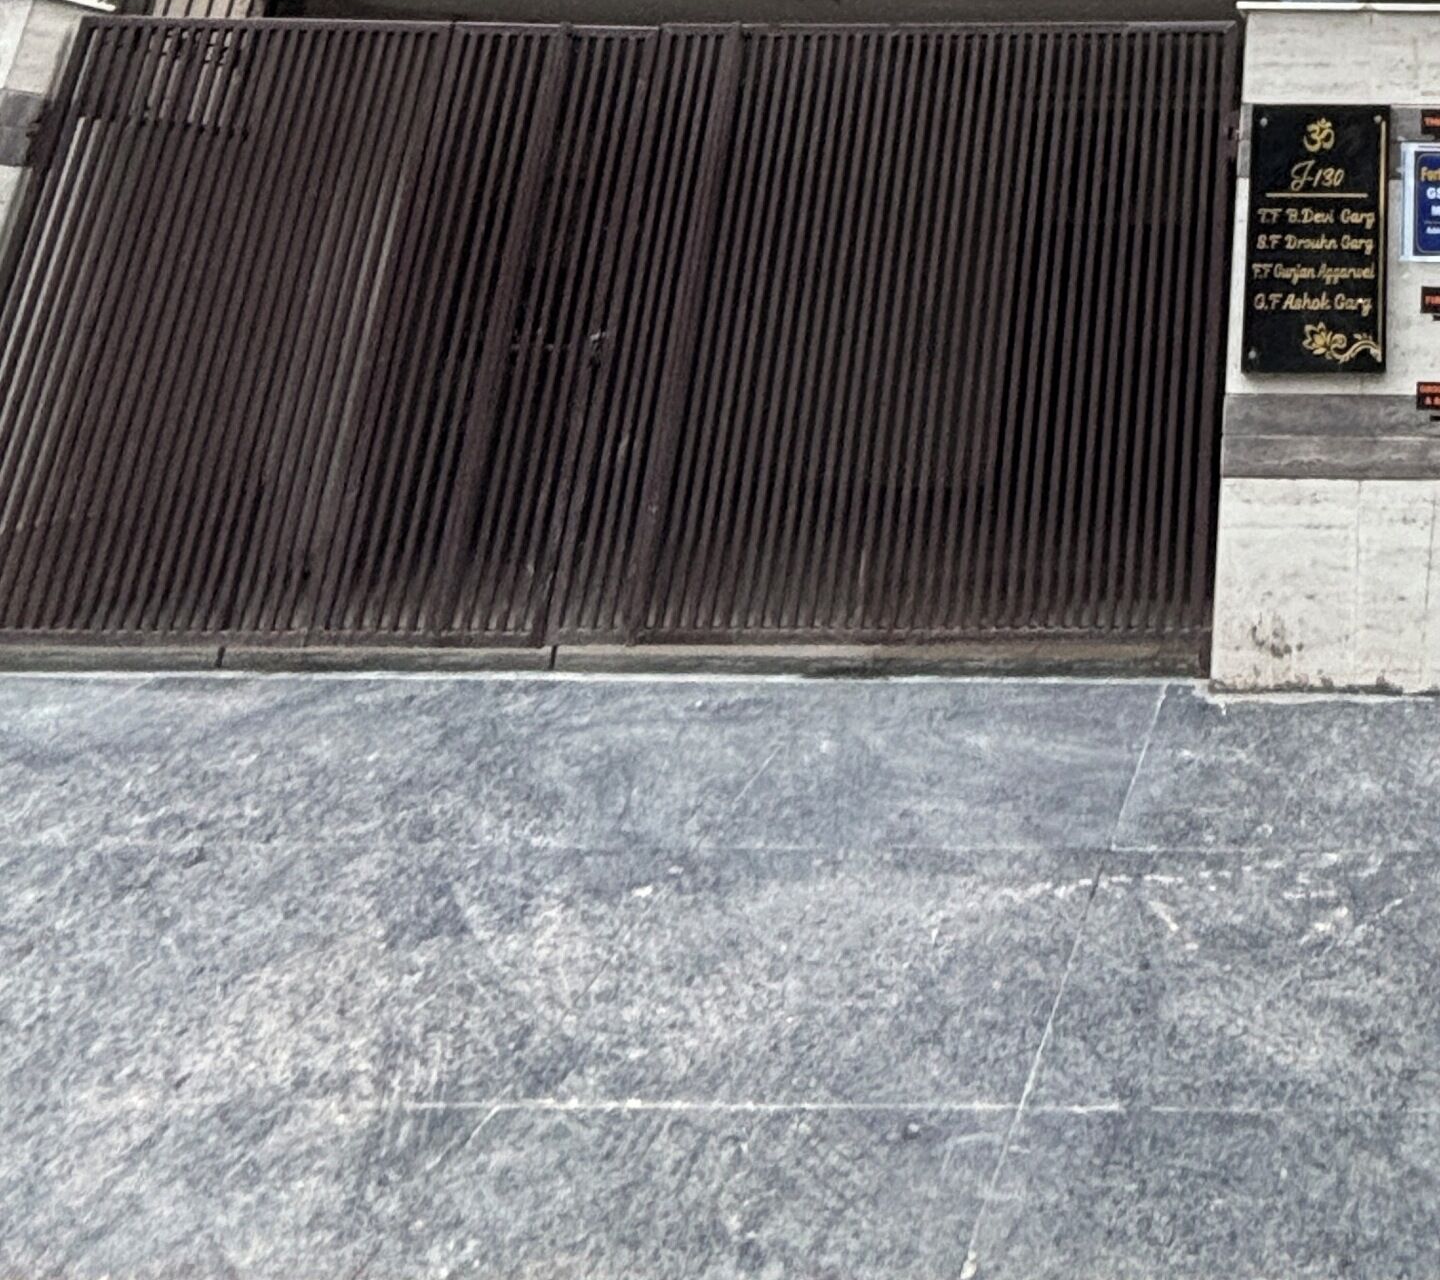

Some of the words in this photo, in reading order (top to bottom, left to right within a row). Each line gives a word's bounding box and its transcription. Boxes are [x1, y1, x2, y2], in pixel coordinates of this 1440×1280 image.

[1340, 208, 1376, 229] Garg
[1340, 234, 1374, 255] Garg
[1282, 291, 1331, 310] Ashok
[1334, 293, 1373, 317] Garg
